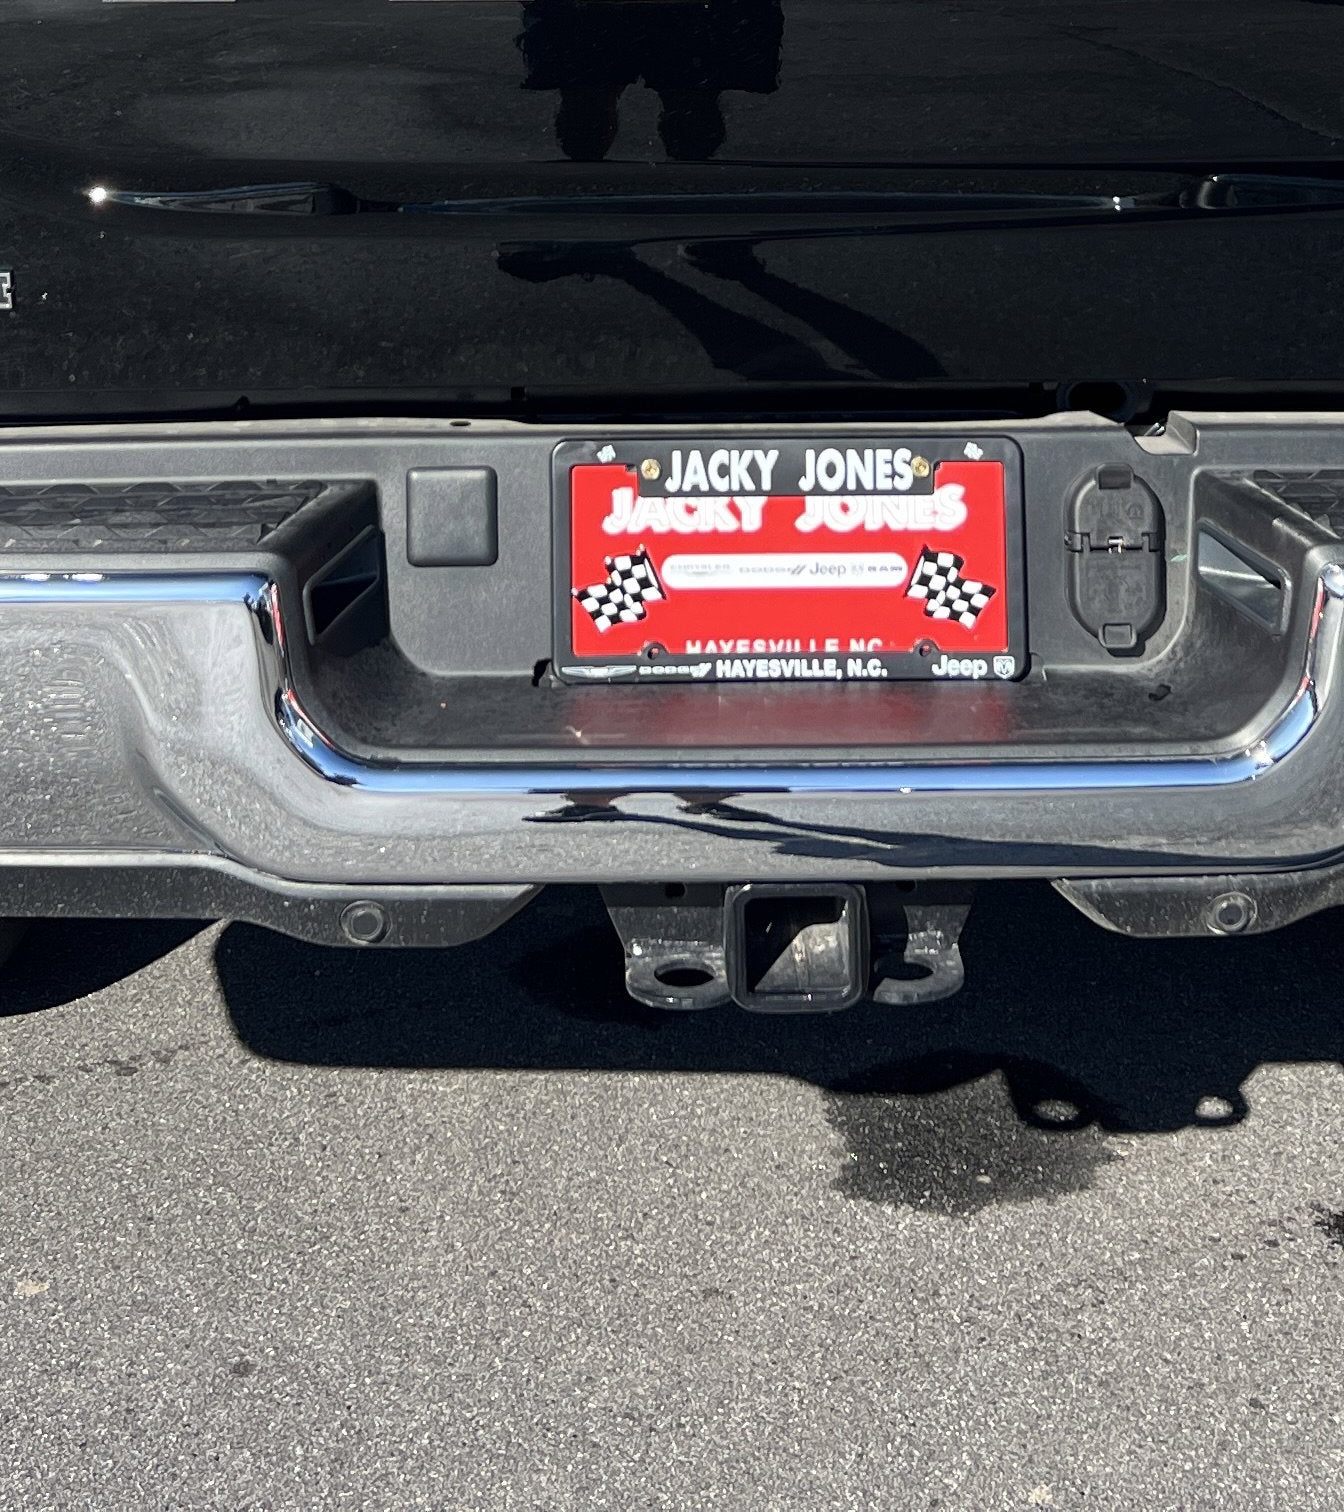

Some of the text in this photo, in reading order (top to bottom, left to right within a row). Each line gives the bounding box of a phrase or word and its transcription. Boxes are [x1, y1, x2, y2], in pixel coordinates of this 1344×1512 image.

[665, 447, 915, 493] JACKY JONES
[601, 482, 968, 534] JACKY JONES
[809, 561, 847, 578] Jeep
[715, 658, 843, 681] HAYESVILLE,
[847, 658, 888, 678] N.C.
[931, 654, 988, 680] Jeep
